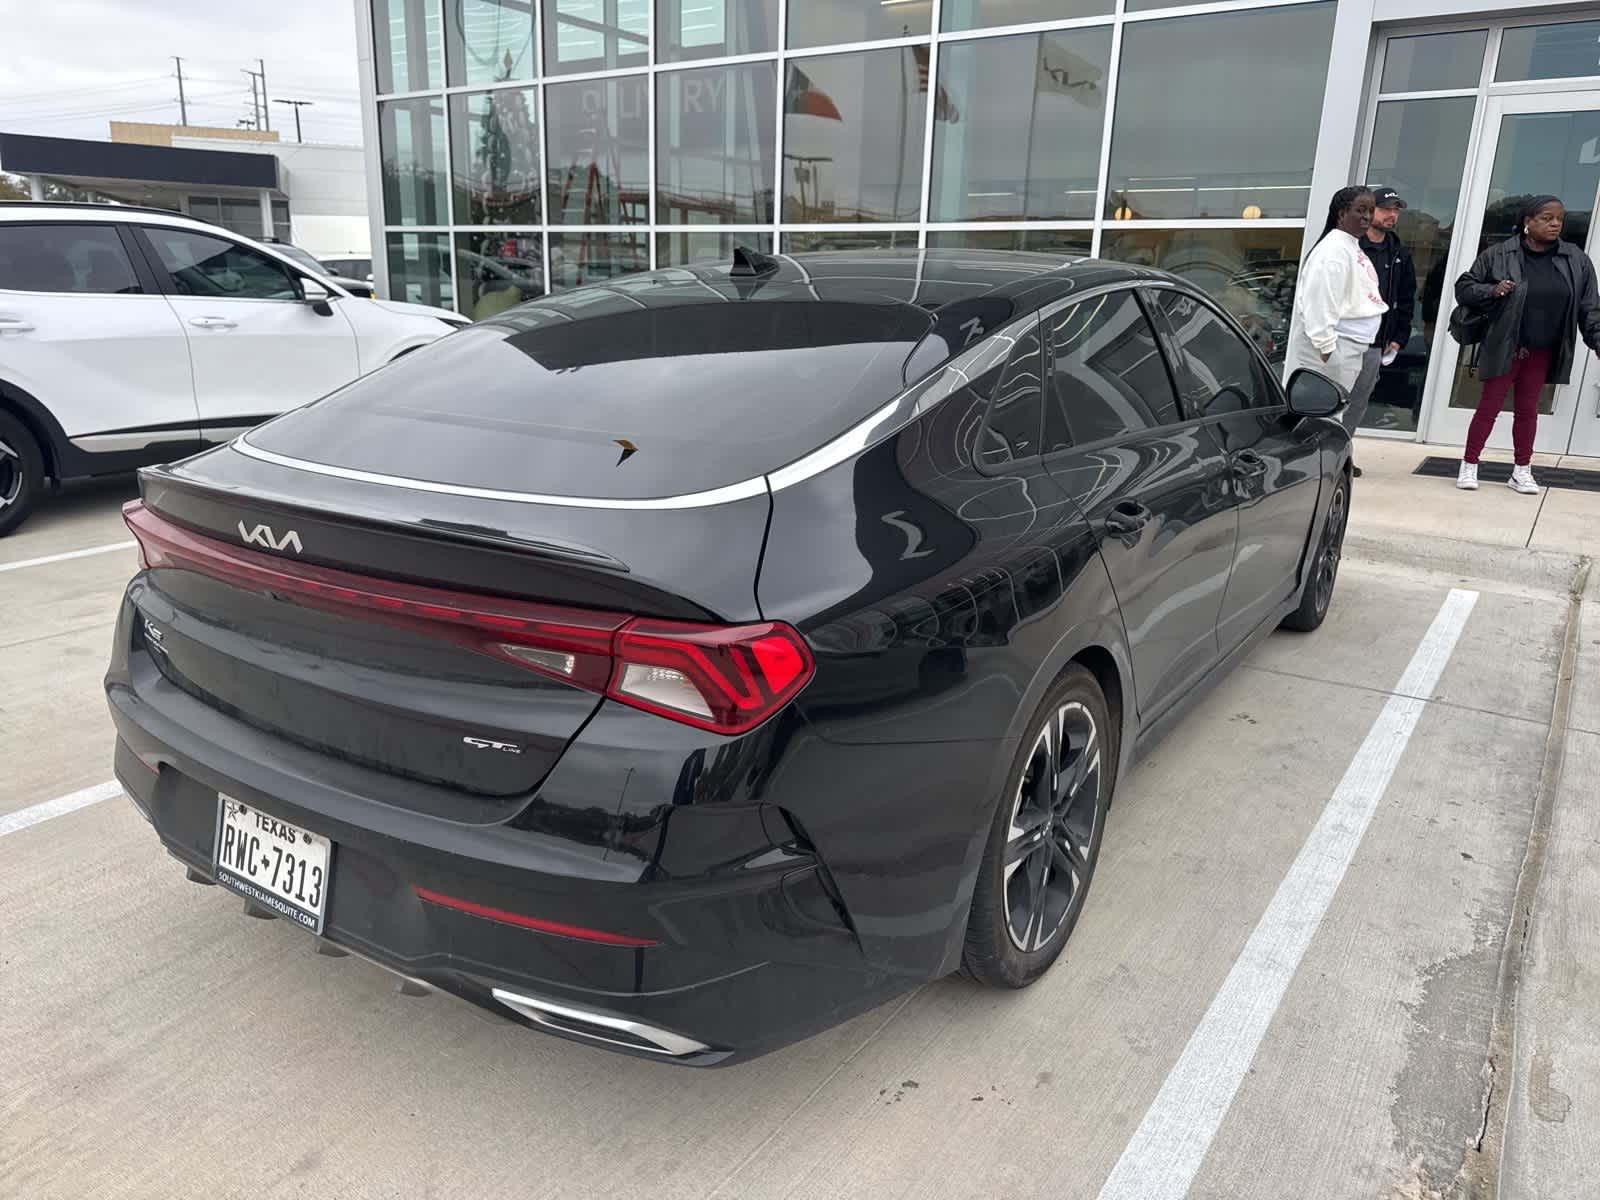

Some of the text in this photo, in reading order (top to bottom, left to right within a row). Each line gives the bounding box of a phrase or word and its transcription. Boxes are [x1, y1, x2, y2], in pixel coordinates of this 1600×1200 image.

[238, 519, 304, 554] KIA
[144, 619, 162, 641] K5
[463, 736, 519, 749] GT
[254, 811, 296, 844] TEXAS
[271, 846, 322, 908] 7313
[218, 871, 316, 929] SOUTHWESTKIAMESQUITE.COM
